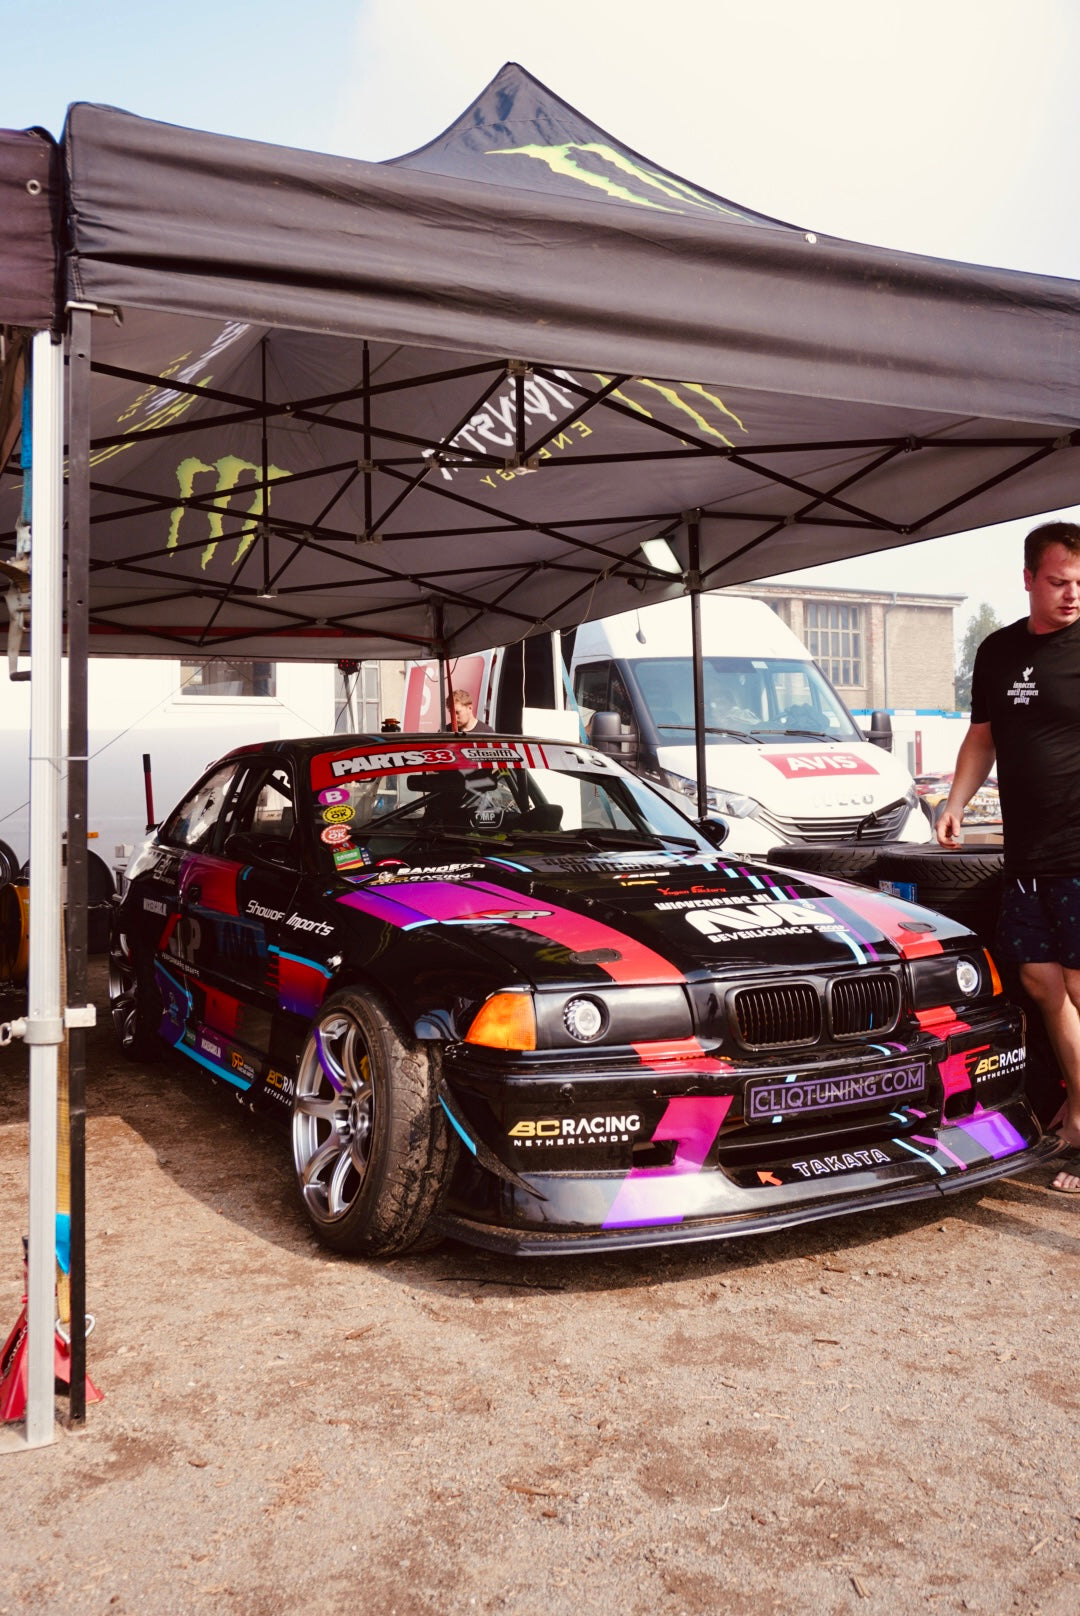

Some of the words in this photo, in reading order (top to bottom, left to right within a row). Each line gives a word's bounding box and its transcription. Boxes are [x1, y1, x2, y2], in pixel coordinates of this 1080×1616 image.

[331, 750, 456, 777] PARTS33
[786, 755, 858, 772] AVIS
[325, 790, 343, 803] B
[331, 812, 347, 820] OK
[328, 832, 345, 840] OK
[285, 911, 335, 937] Imports
[707, 925, 813, 944] BEVEILIGINGS
[999, 1045, 1027, 1068] RACIN
[755, 1076, 877, 1112] CLIQTUNING
[881, 1070, 922, 1093] COM
[513, 1134, 630, 1147] NETHERLANDS
[792, 1149, 891, 1178] TAKATA
